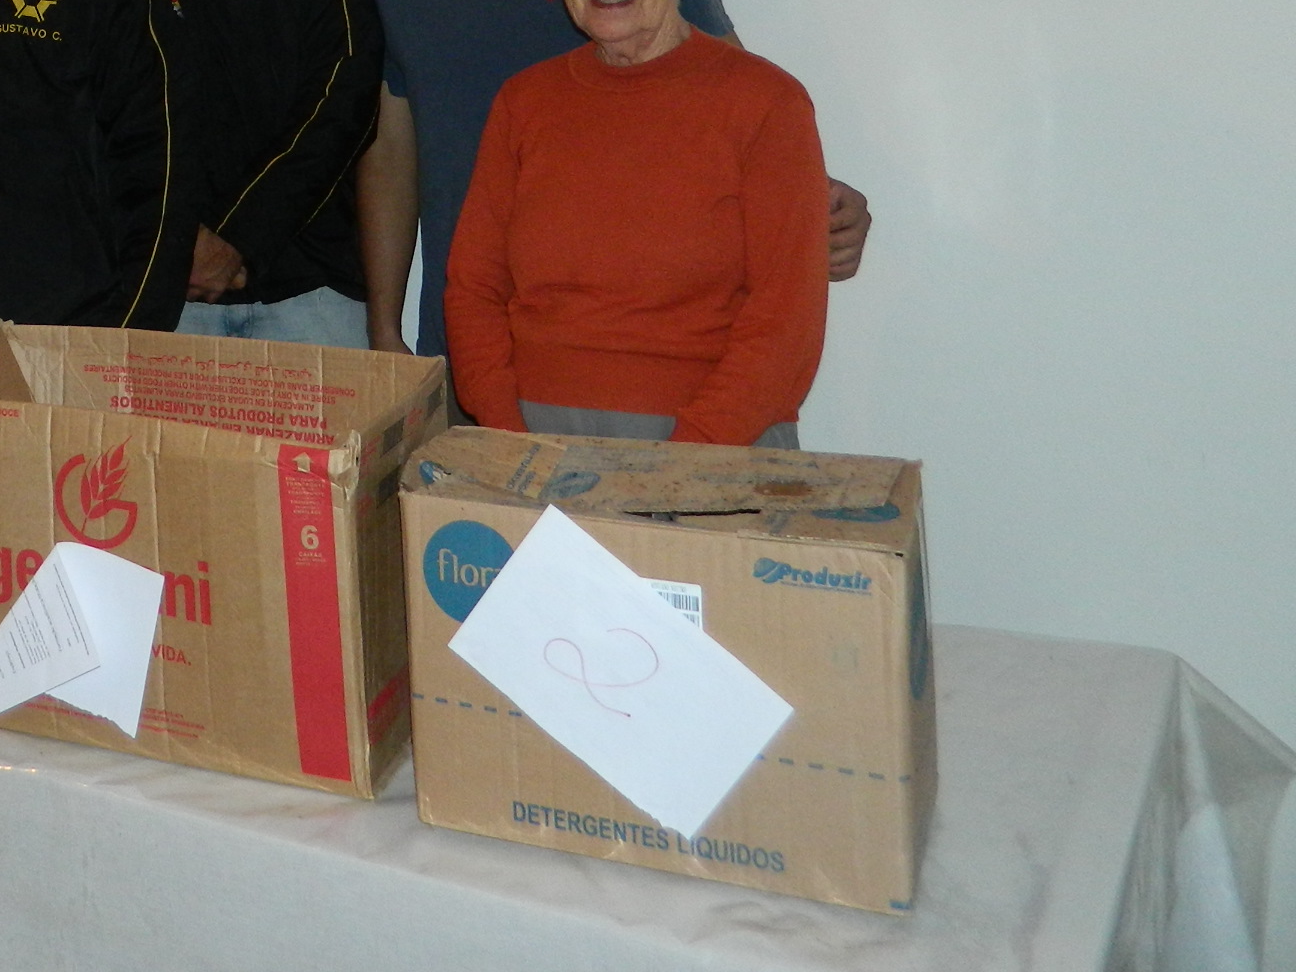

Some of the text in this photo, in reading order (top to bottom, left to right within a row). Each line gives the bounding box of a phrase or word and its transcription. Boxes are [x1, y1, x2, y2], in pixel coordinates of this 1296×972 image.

[52, 31, 63, 42] C.
[103, 374, 141, 385] PRODUCTS
[173, 371, 188, 380] LES
[189, 372, 209, 383] POUR
[143, 378, 163, 387] FOOD
[163, 379, 188, 390] OTHER
[190, 381, 209, 390] WITH
[249, 378, 273, 389] LOCAL
[287, 382, 308, 392] DANS
[165, 389, 184, 399] PARA
[209, 384, 249, 396] TOGETHER
[277, 391, 292, 400] DRY
[186, 391, 226, 402] EXCLUSIVO
[227, 395, 253, 406] LUGAR
[301, 394, 309, 402] IN
[311, 394, 336, 405] STORE
[255, 398, 266, 407] EN
[267, 399, 315, 412] ALMACENAR
[209, 405, 285, 426] PRODUTOS
[288, 414, 327, 430] PARA
[245, 425, 335, 446] ARMAZENAR
[300, 525, 320, 550] 6
[436, 547, 500, 587] flor
[776, 562, 873, 591] Produxir
[512, 800, 670, 851] DETERGENTES
